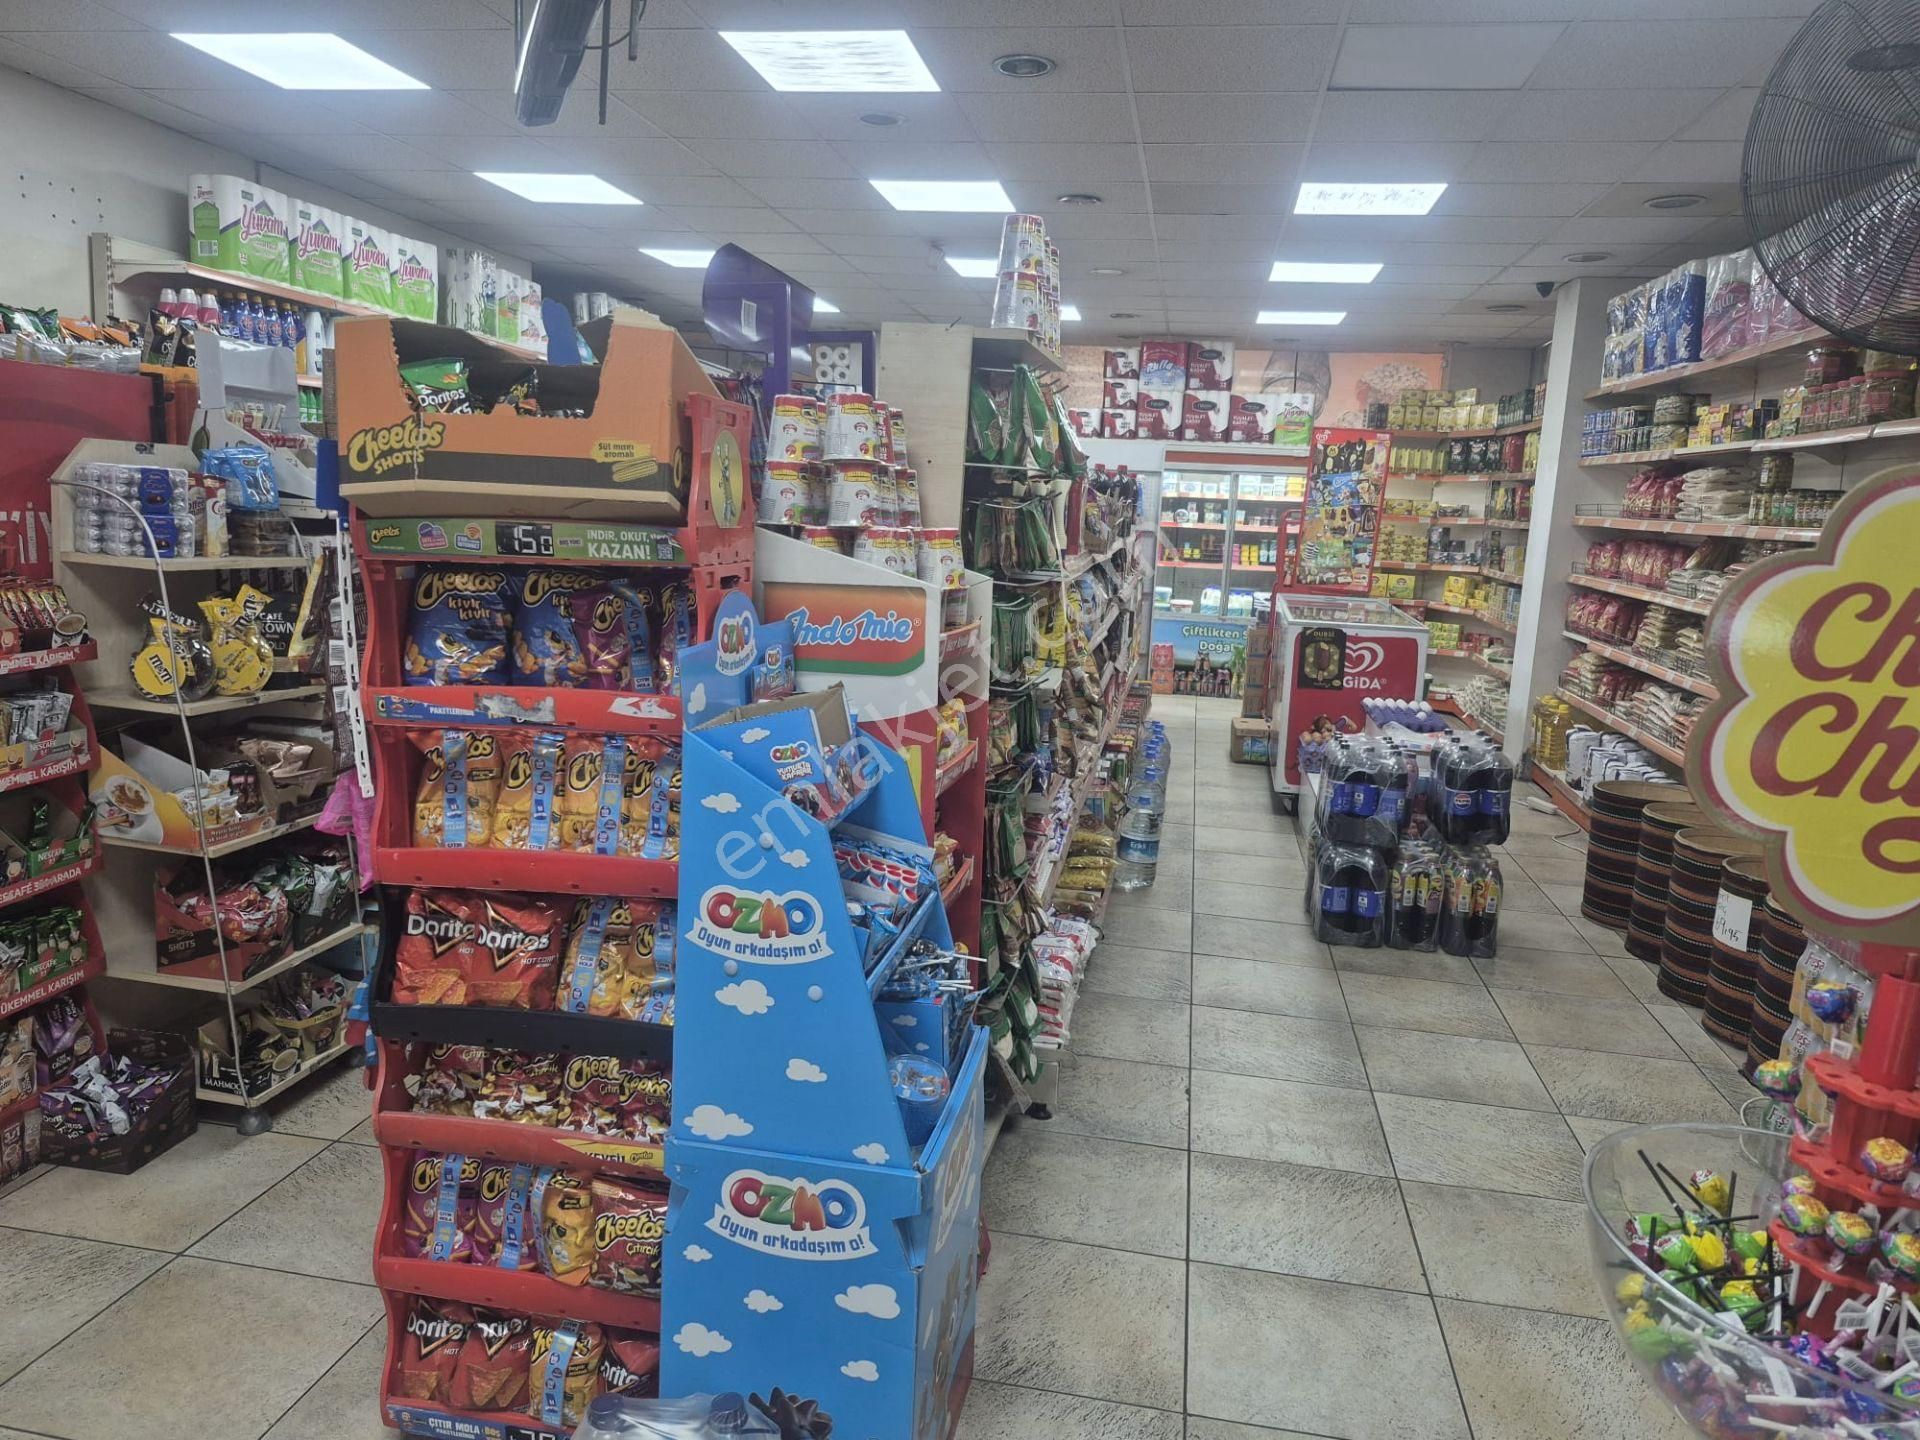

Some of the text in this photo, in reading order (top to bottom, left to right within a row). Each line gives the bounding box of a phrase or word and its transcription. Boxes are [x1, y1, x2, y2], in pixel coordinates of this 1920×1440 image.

[418, 387, 466, 407] Doritos
[347, 412, 446, 472] Cheetos
[370, 526, 401, 544] Cheetos
[587, 542, 652, 560] KAZAN!
[415, 570, 505, 610] Cheetos
[1182, 626, 1240, 638] Çiftlikten
[771, 741, 811, 762] OZMO
[706, 890, 818, 939] OZMO
[168, 938, 196, 953] SHOTS
[697, 926, 823, 960] Oyun arkadaşım o!
[48, 970, 86, 995] KARIŞIM
[729, 1177, 858, 1232] OZMO
[594, 1208, 667, 1252] Cheetos
[718, 1214, 866, 1257] Oyun arkadaşım o!
[428, 1417, 452, 1430] ÇITIR
[455, 1422, 481, 1435] MOLA
